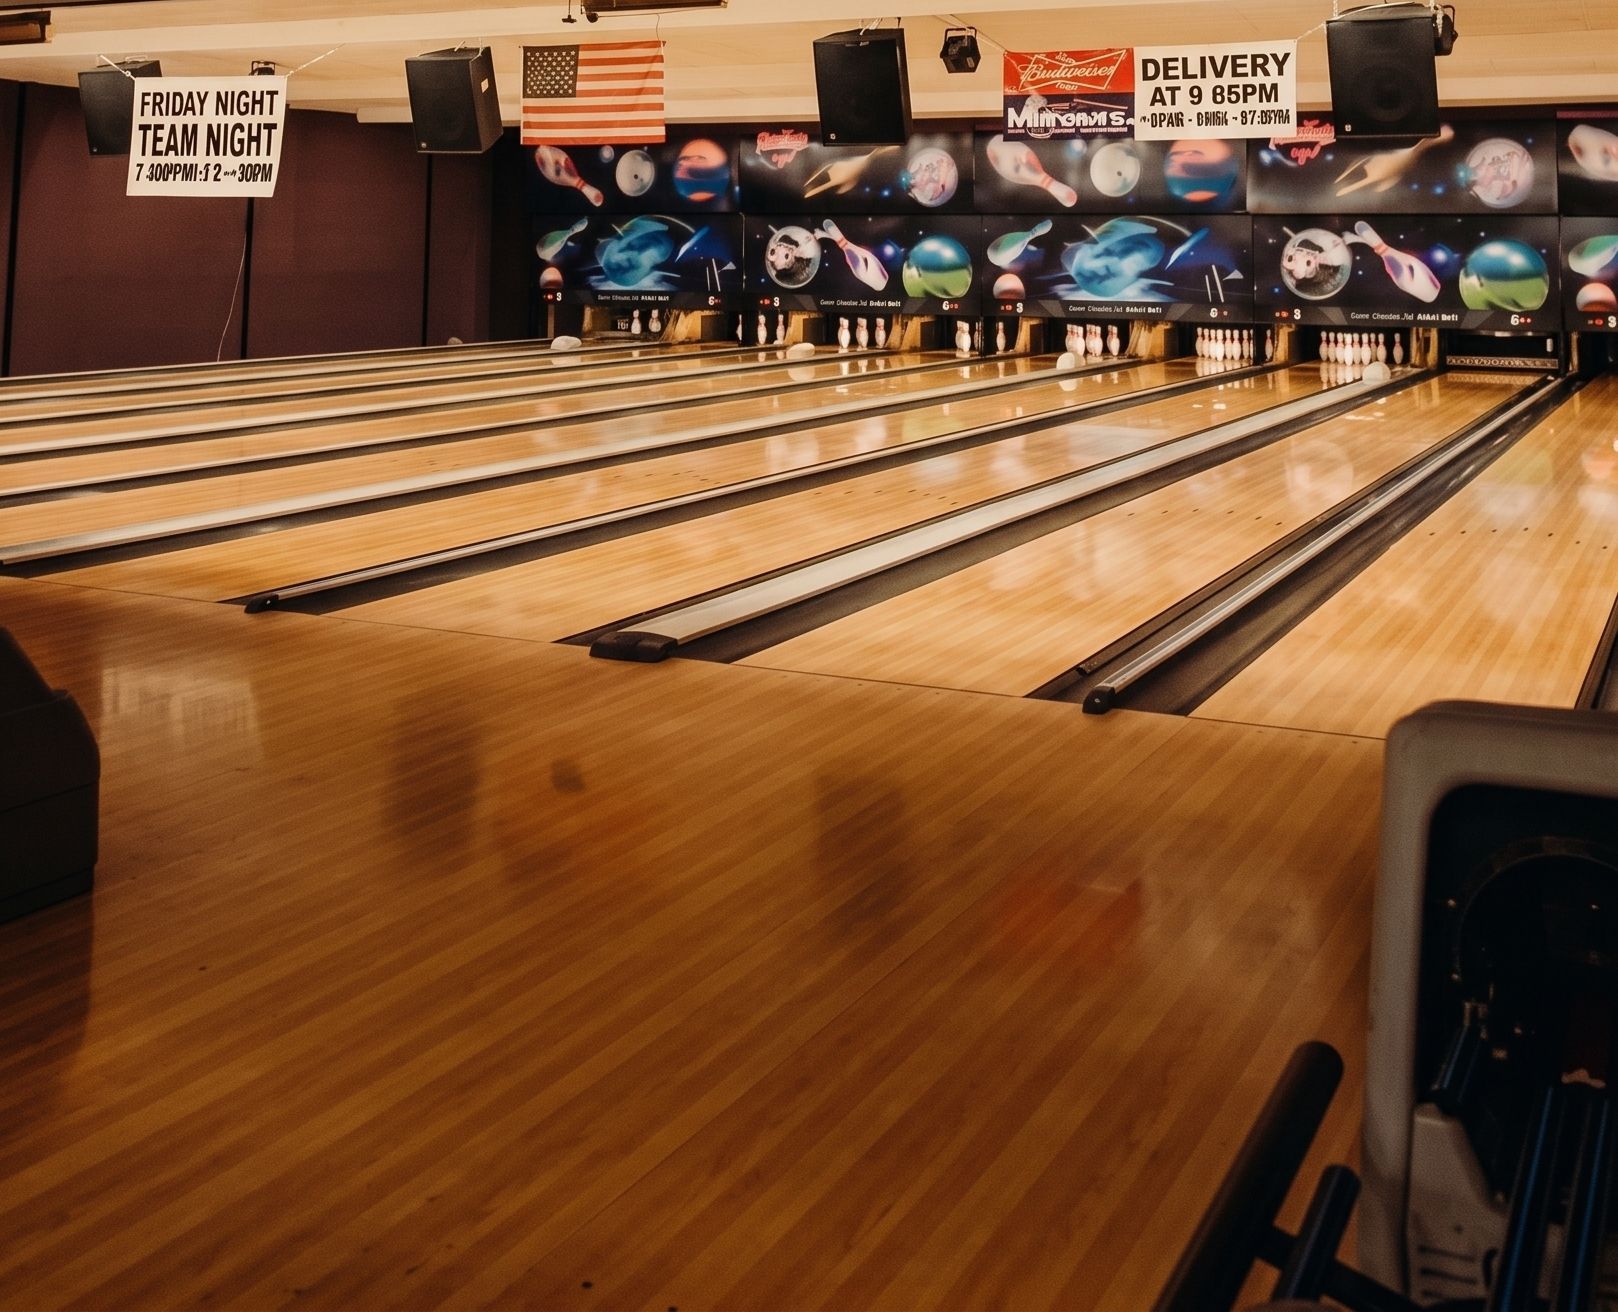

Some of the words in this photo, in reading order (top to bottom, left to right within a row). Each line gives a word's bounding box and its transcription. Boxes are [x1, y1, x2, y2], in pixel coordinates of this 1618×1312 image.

[1141, 52, 1291, 81] DELIVERY
[140, 91, 209, 116] FRIDAY
[215, 90, 279, 116] NIGHT
[1149, 86, 1181, 106] AT
[1188, 85, 1203, 105] 9
[138, 123, 198, 157] TEAM
[205, 123, 278, 157] NIGHT
